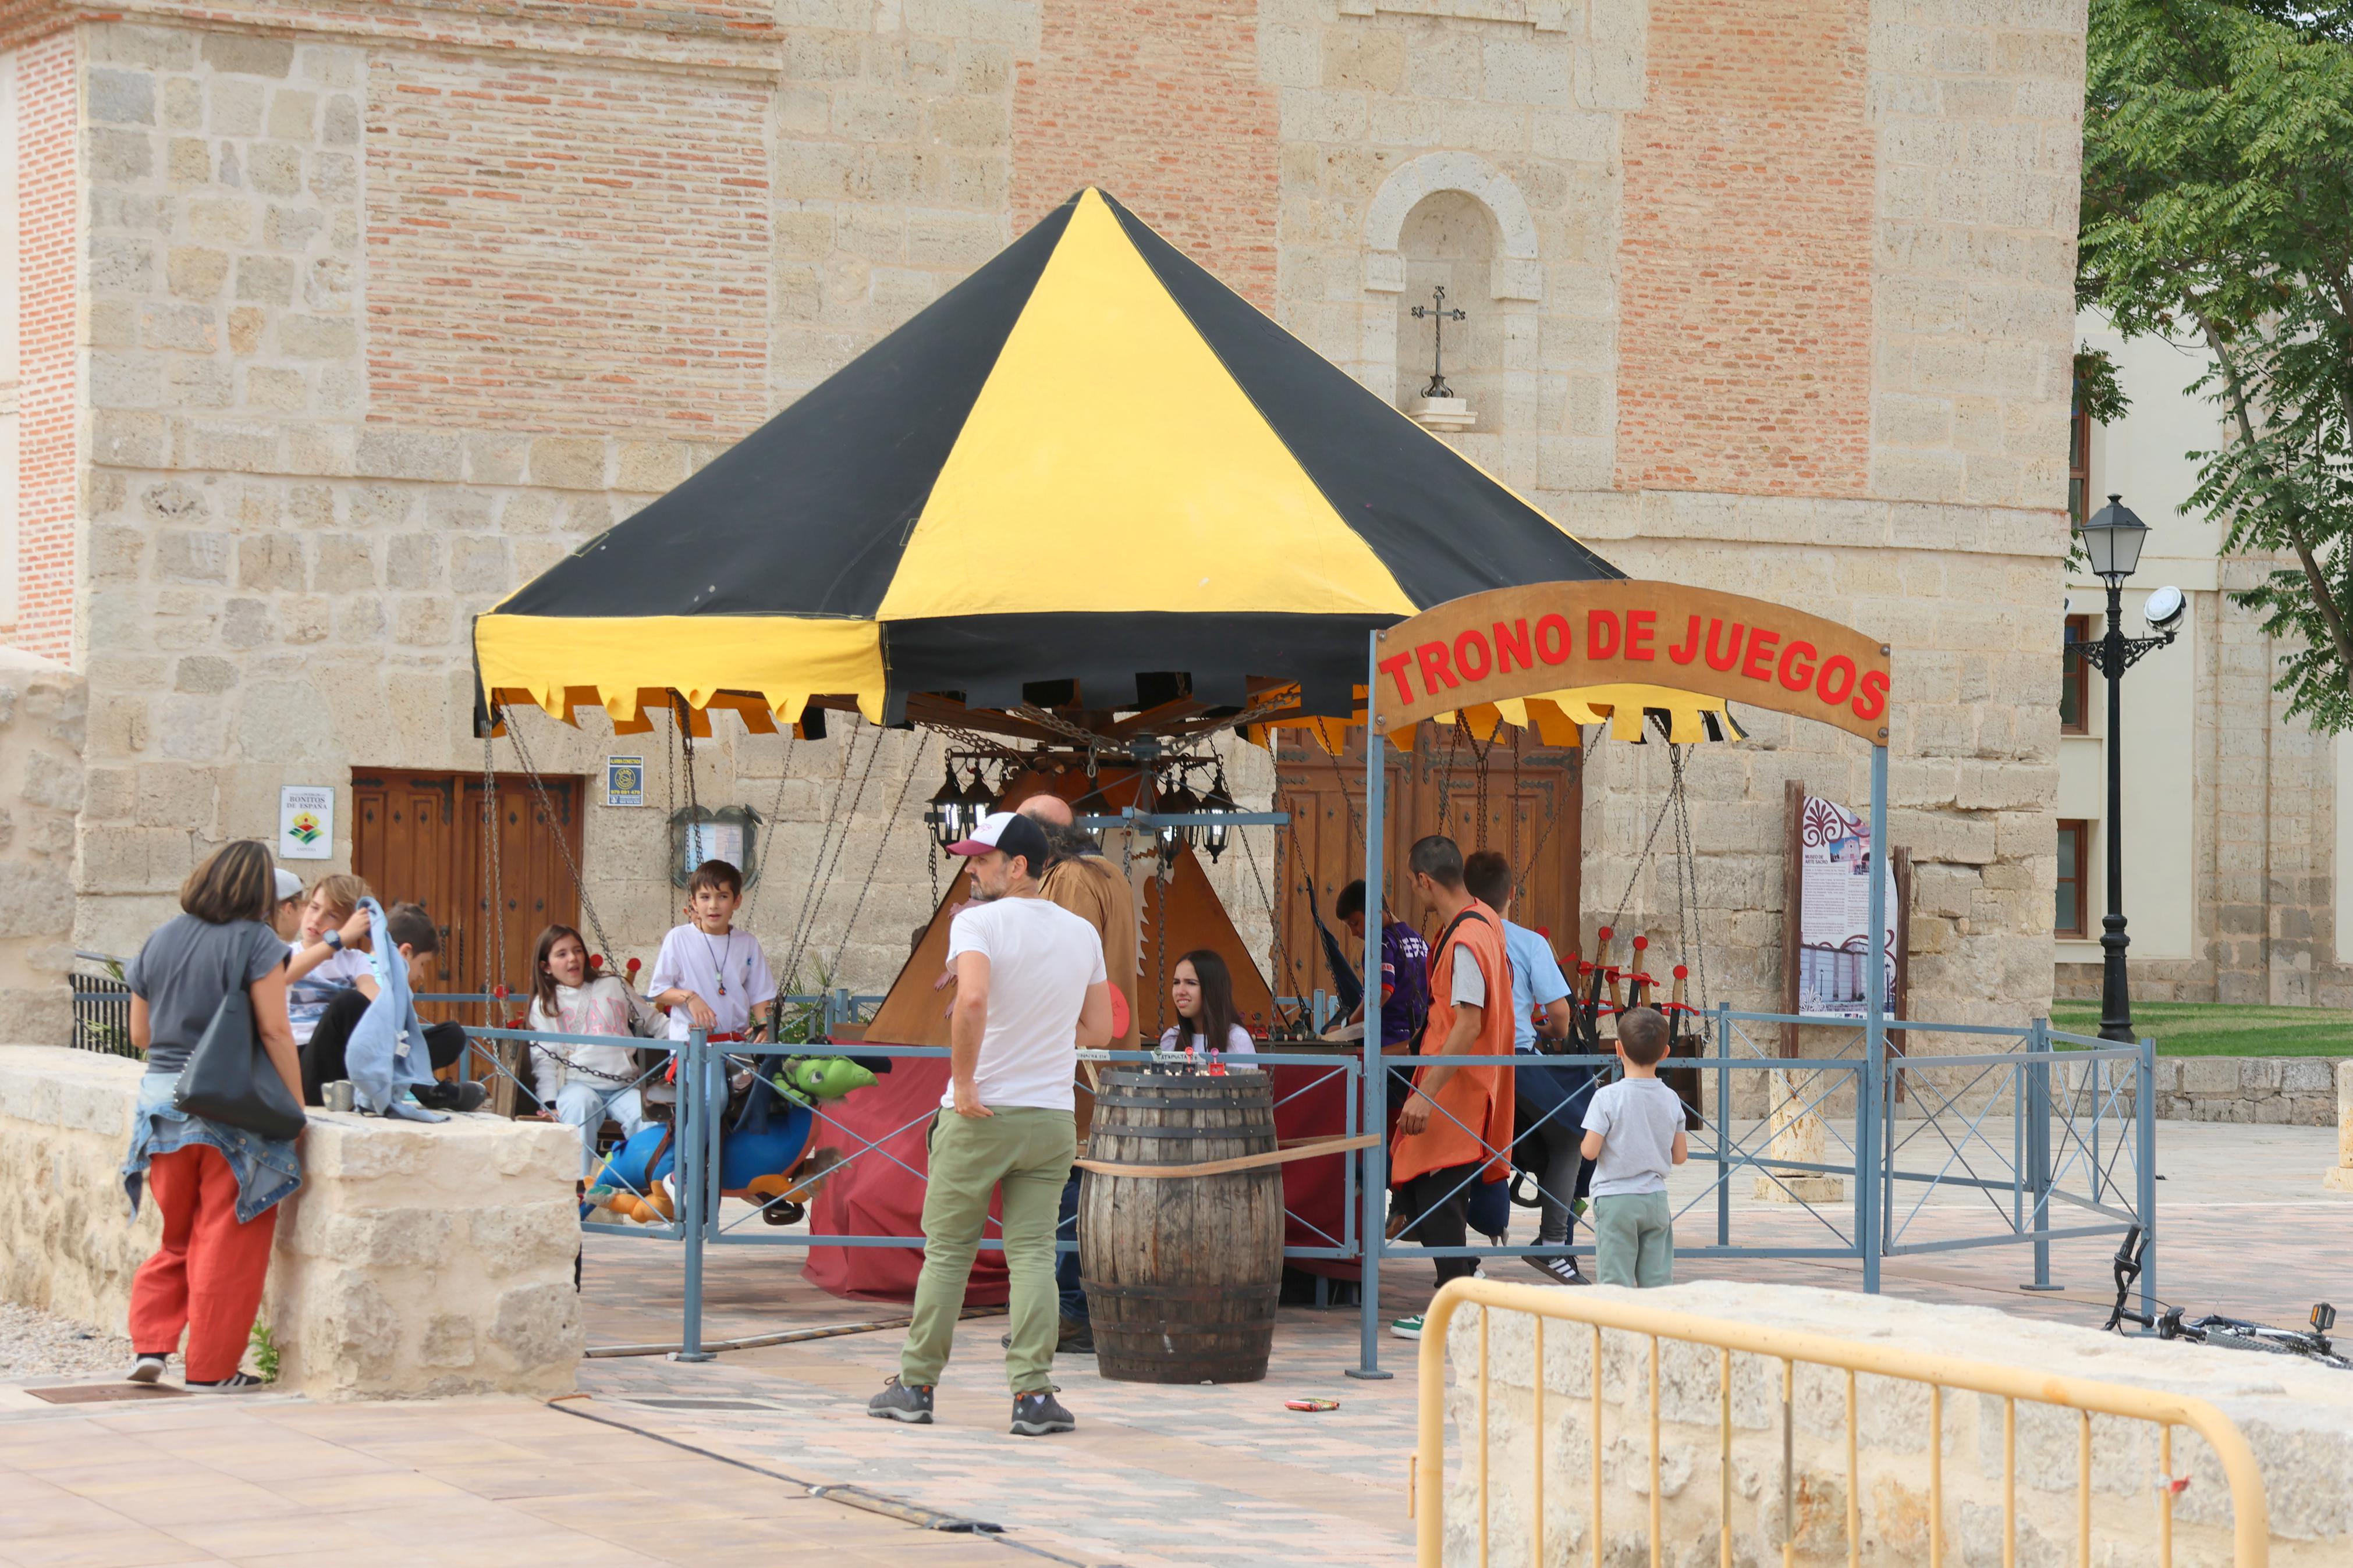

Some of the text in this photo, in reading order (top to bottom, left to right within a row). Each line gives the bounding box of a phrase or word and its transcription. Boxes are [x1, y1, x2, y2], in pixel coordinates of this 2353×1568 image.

[1378, 610, 1891, 720] TRONO DE JUEGOS
